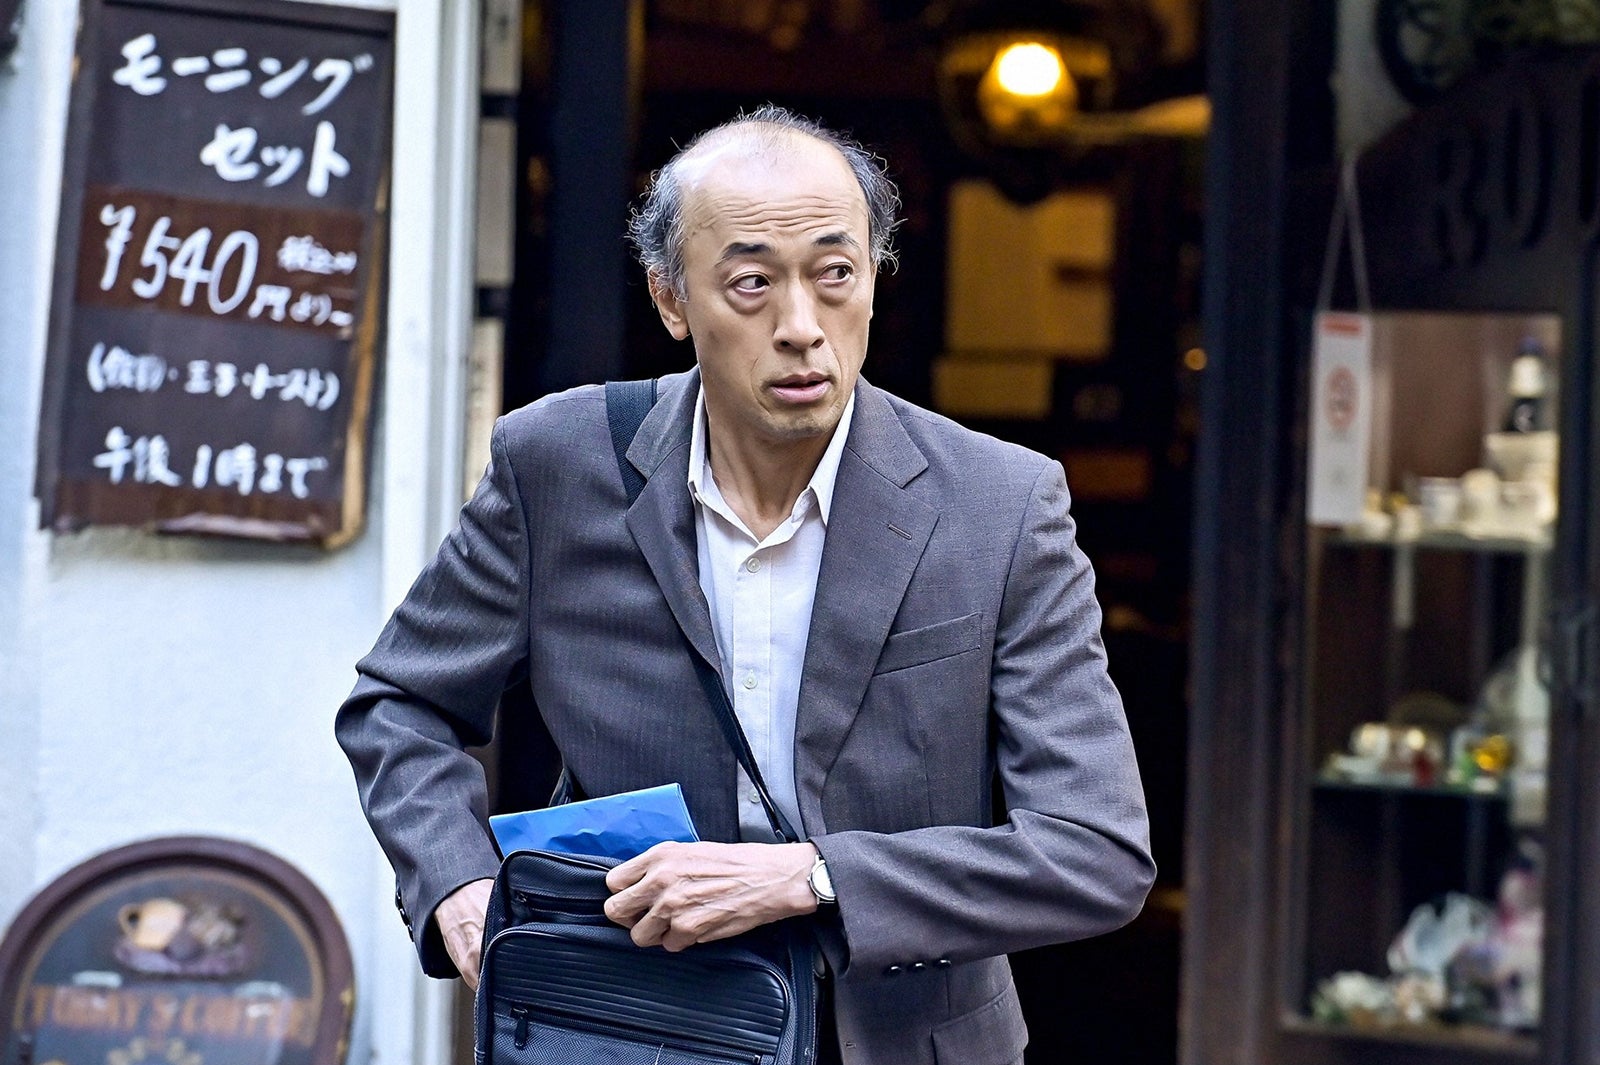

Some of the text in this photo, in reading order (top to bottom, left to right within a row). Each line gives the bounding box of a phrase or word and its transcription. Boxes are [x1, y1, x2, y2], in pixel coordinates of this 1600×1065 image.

[113, 33, 374, 115] モーニング
[200, 120, 350, 197] セット
